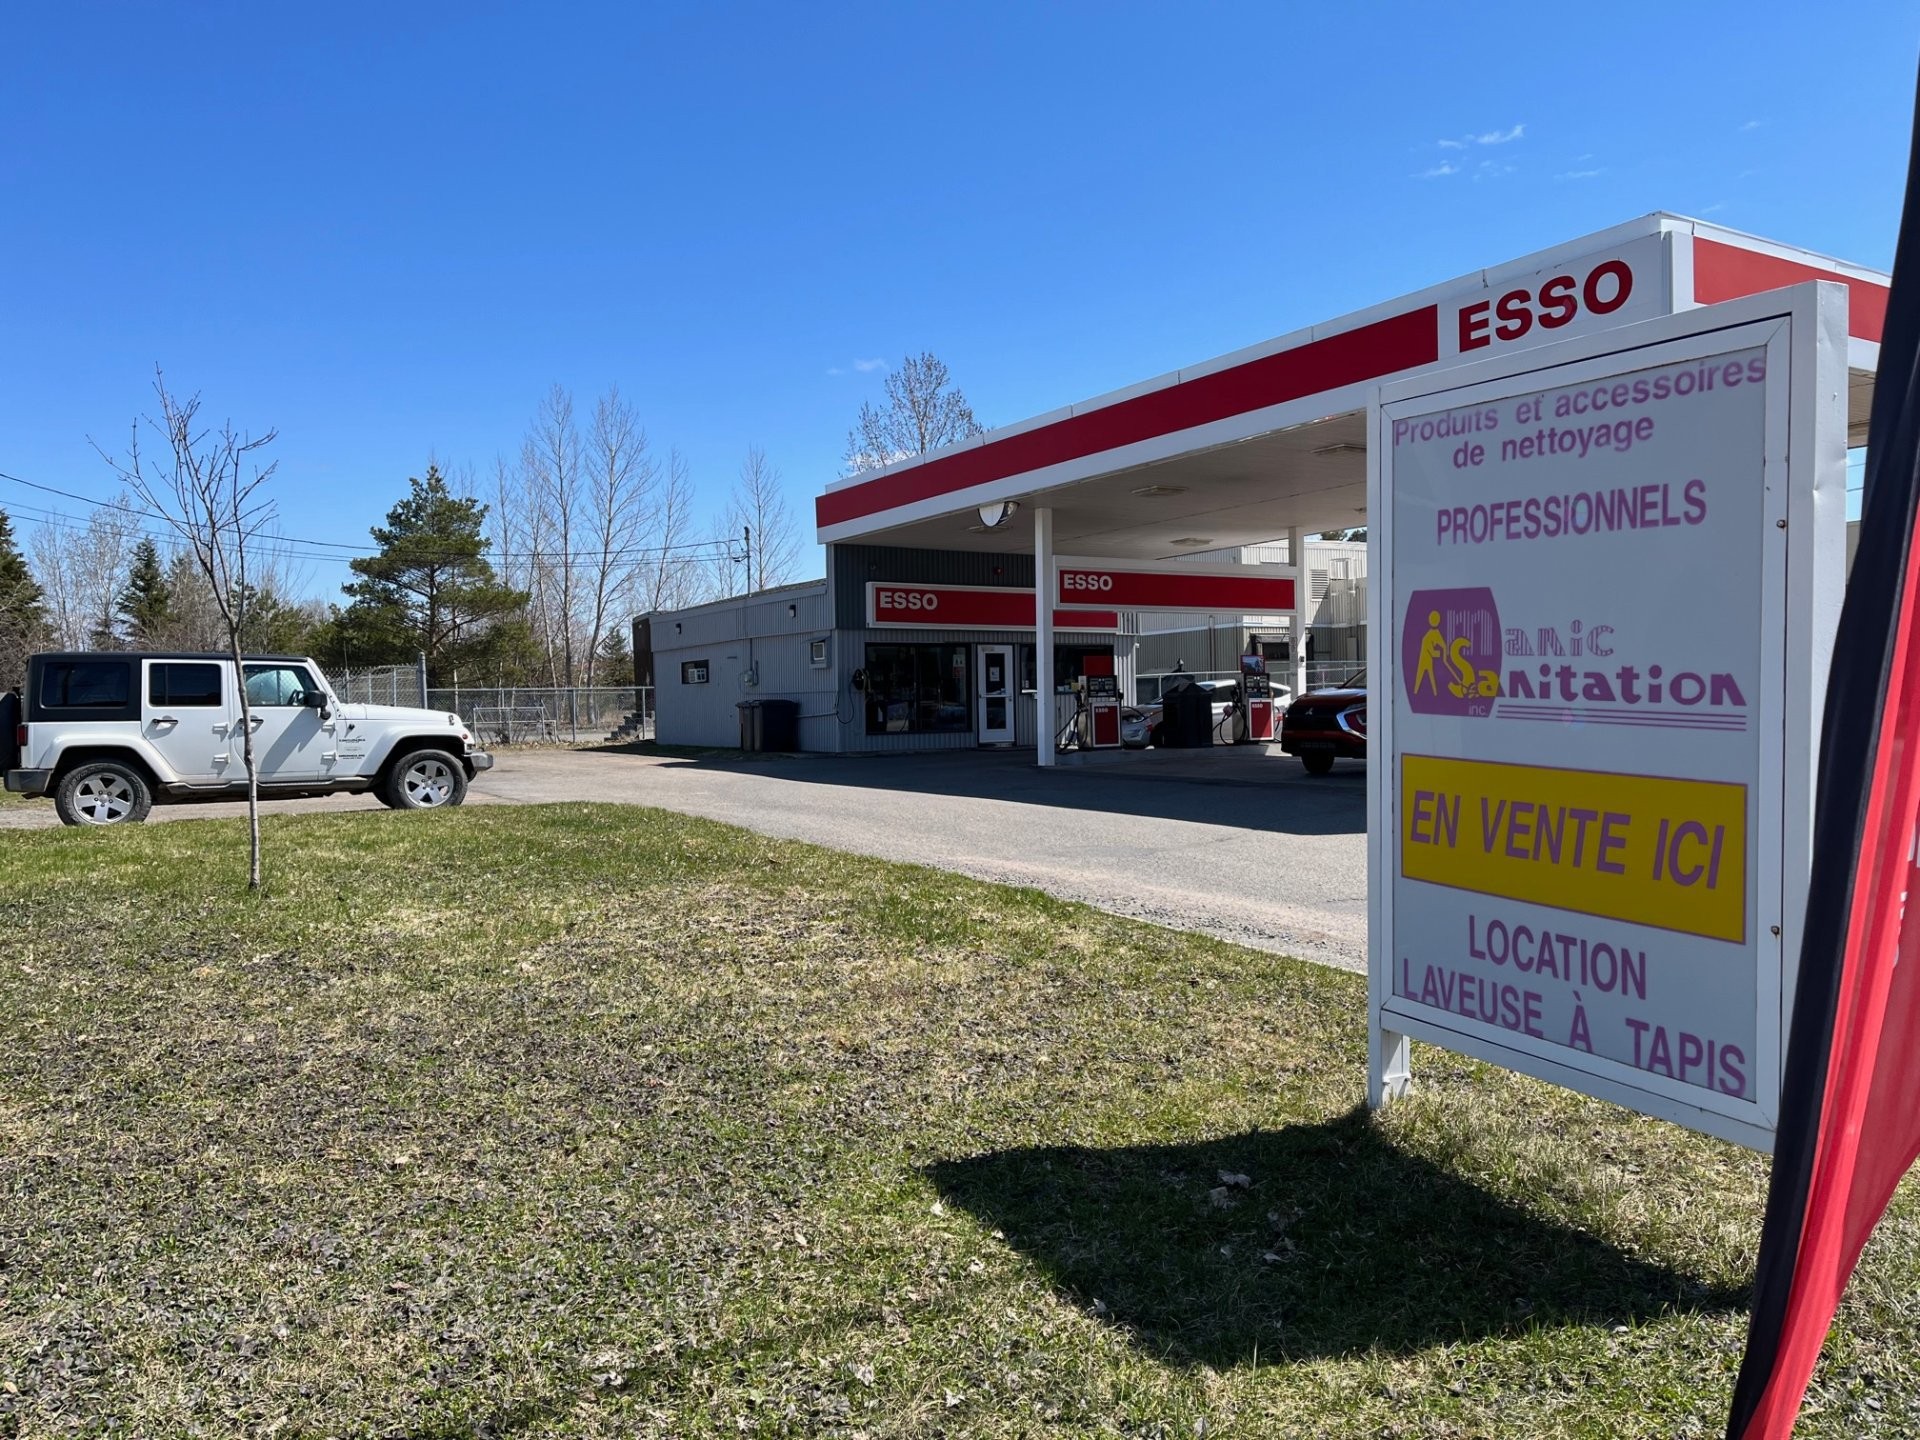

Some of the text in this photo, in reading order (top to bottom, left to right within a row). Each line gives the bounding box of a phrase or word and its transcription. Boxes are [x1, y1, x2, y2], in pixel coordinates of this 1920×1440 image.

[1458, 259, 1633, 353] ESSO
[1394, 357, 1766, 447] Produits et accessoires
[1453, 416, 1655, 469] de nettoyage
[1437, 479, 1707, 546] PROFESSIONNELS
[879, 591, 938, 610] ESSO
[1063, 573, 1113, 591] ESSO
[1410, 790, 1725, 890] EN VENTE ICI
[1468, 914, 1647, 1000] LOCATION
[1403, 958, 1746, 1099] LAVEUSE À TAPIS
